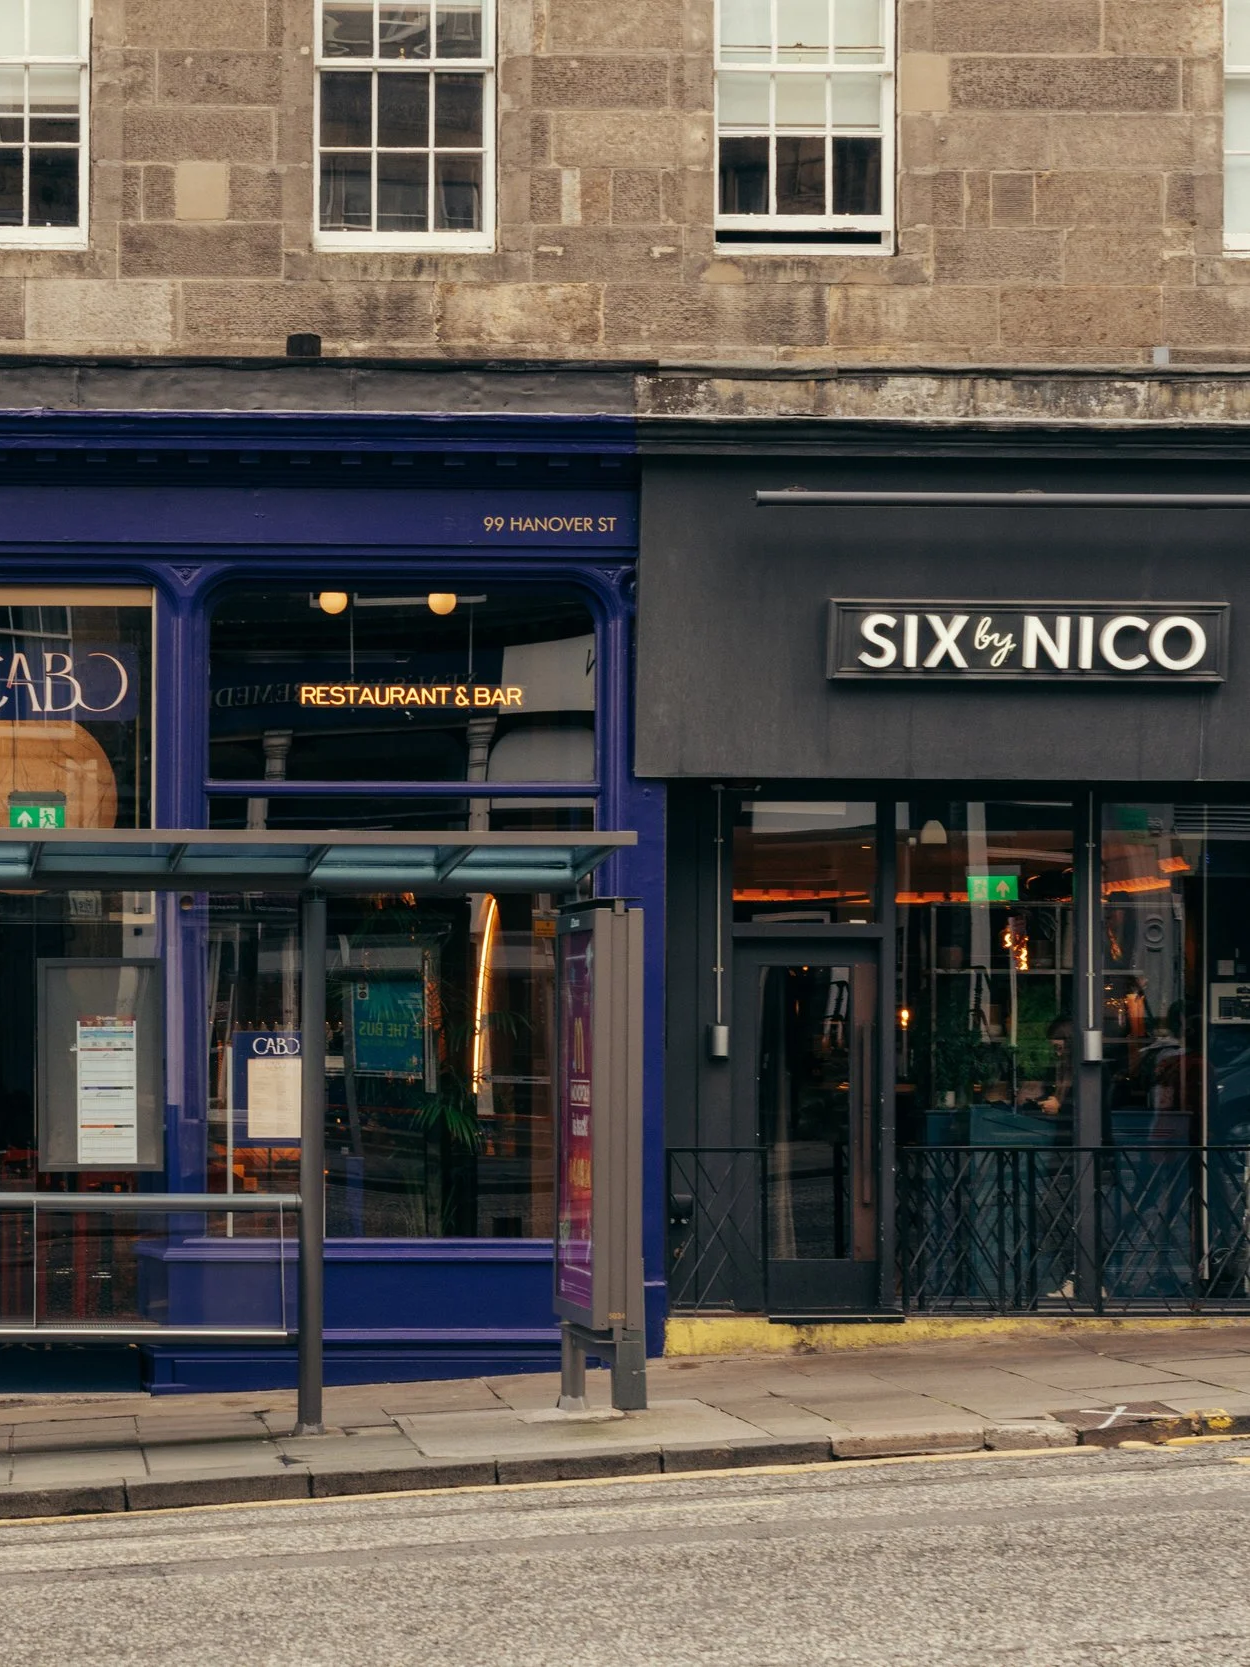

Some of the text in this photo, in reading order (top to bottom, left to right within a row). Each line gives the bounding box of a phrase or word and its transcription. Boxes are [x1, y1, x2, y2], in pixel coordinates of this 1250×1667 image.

[483, 516, 617, 533] 99 HANOVER ST
[857, 613, 1207, 671] SIX by NICO
[300, 686, 523, 707] RESTAURANT & BAR
[252, 1037, 300, 1055] CABO
